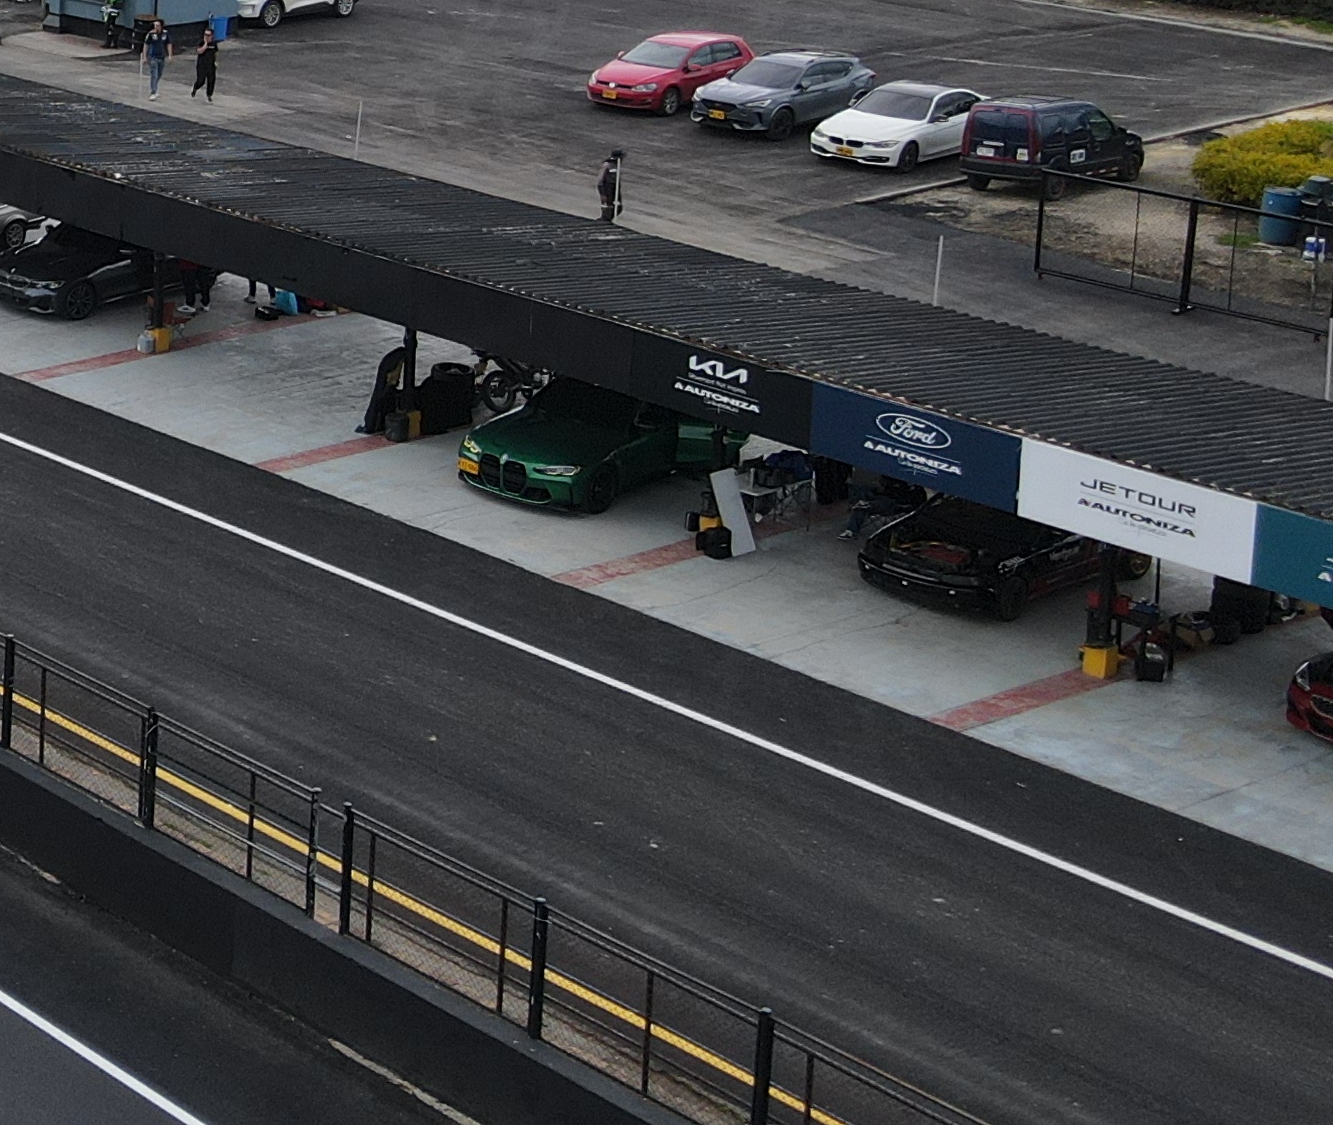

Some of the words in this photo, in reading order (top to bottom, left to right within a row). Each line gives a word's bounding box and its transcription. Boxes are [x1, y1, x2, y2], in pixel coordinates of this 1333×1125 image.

[689, 355, 748, 384] KIA
[890, 417, 937, 445] Ford
[1080, 479, 1196, 519] JETOUR
